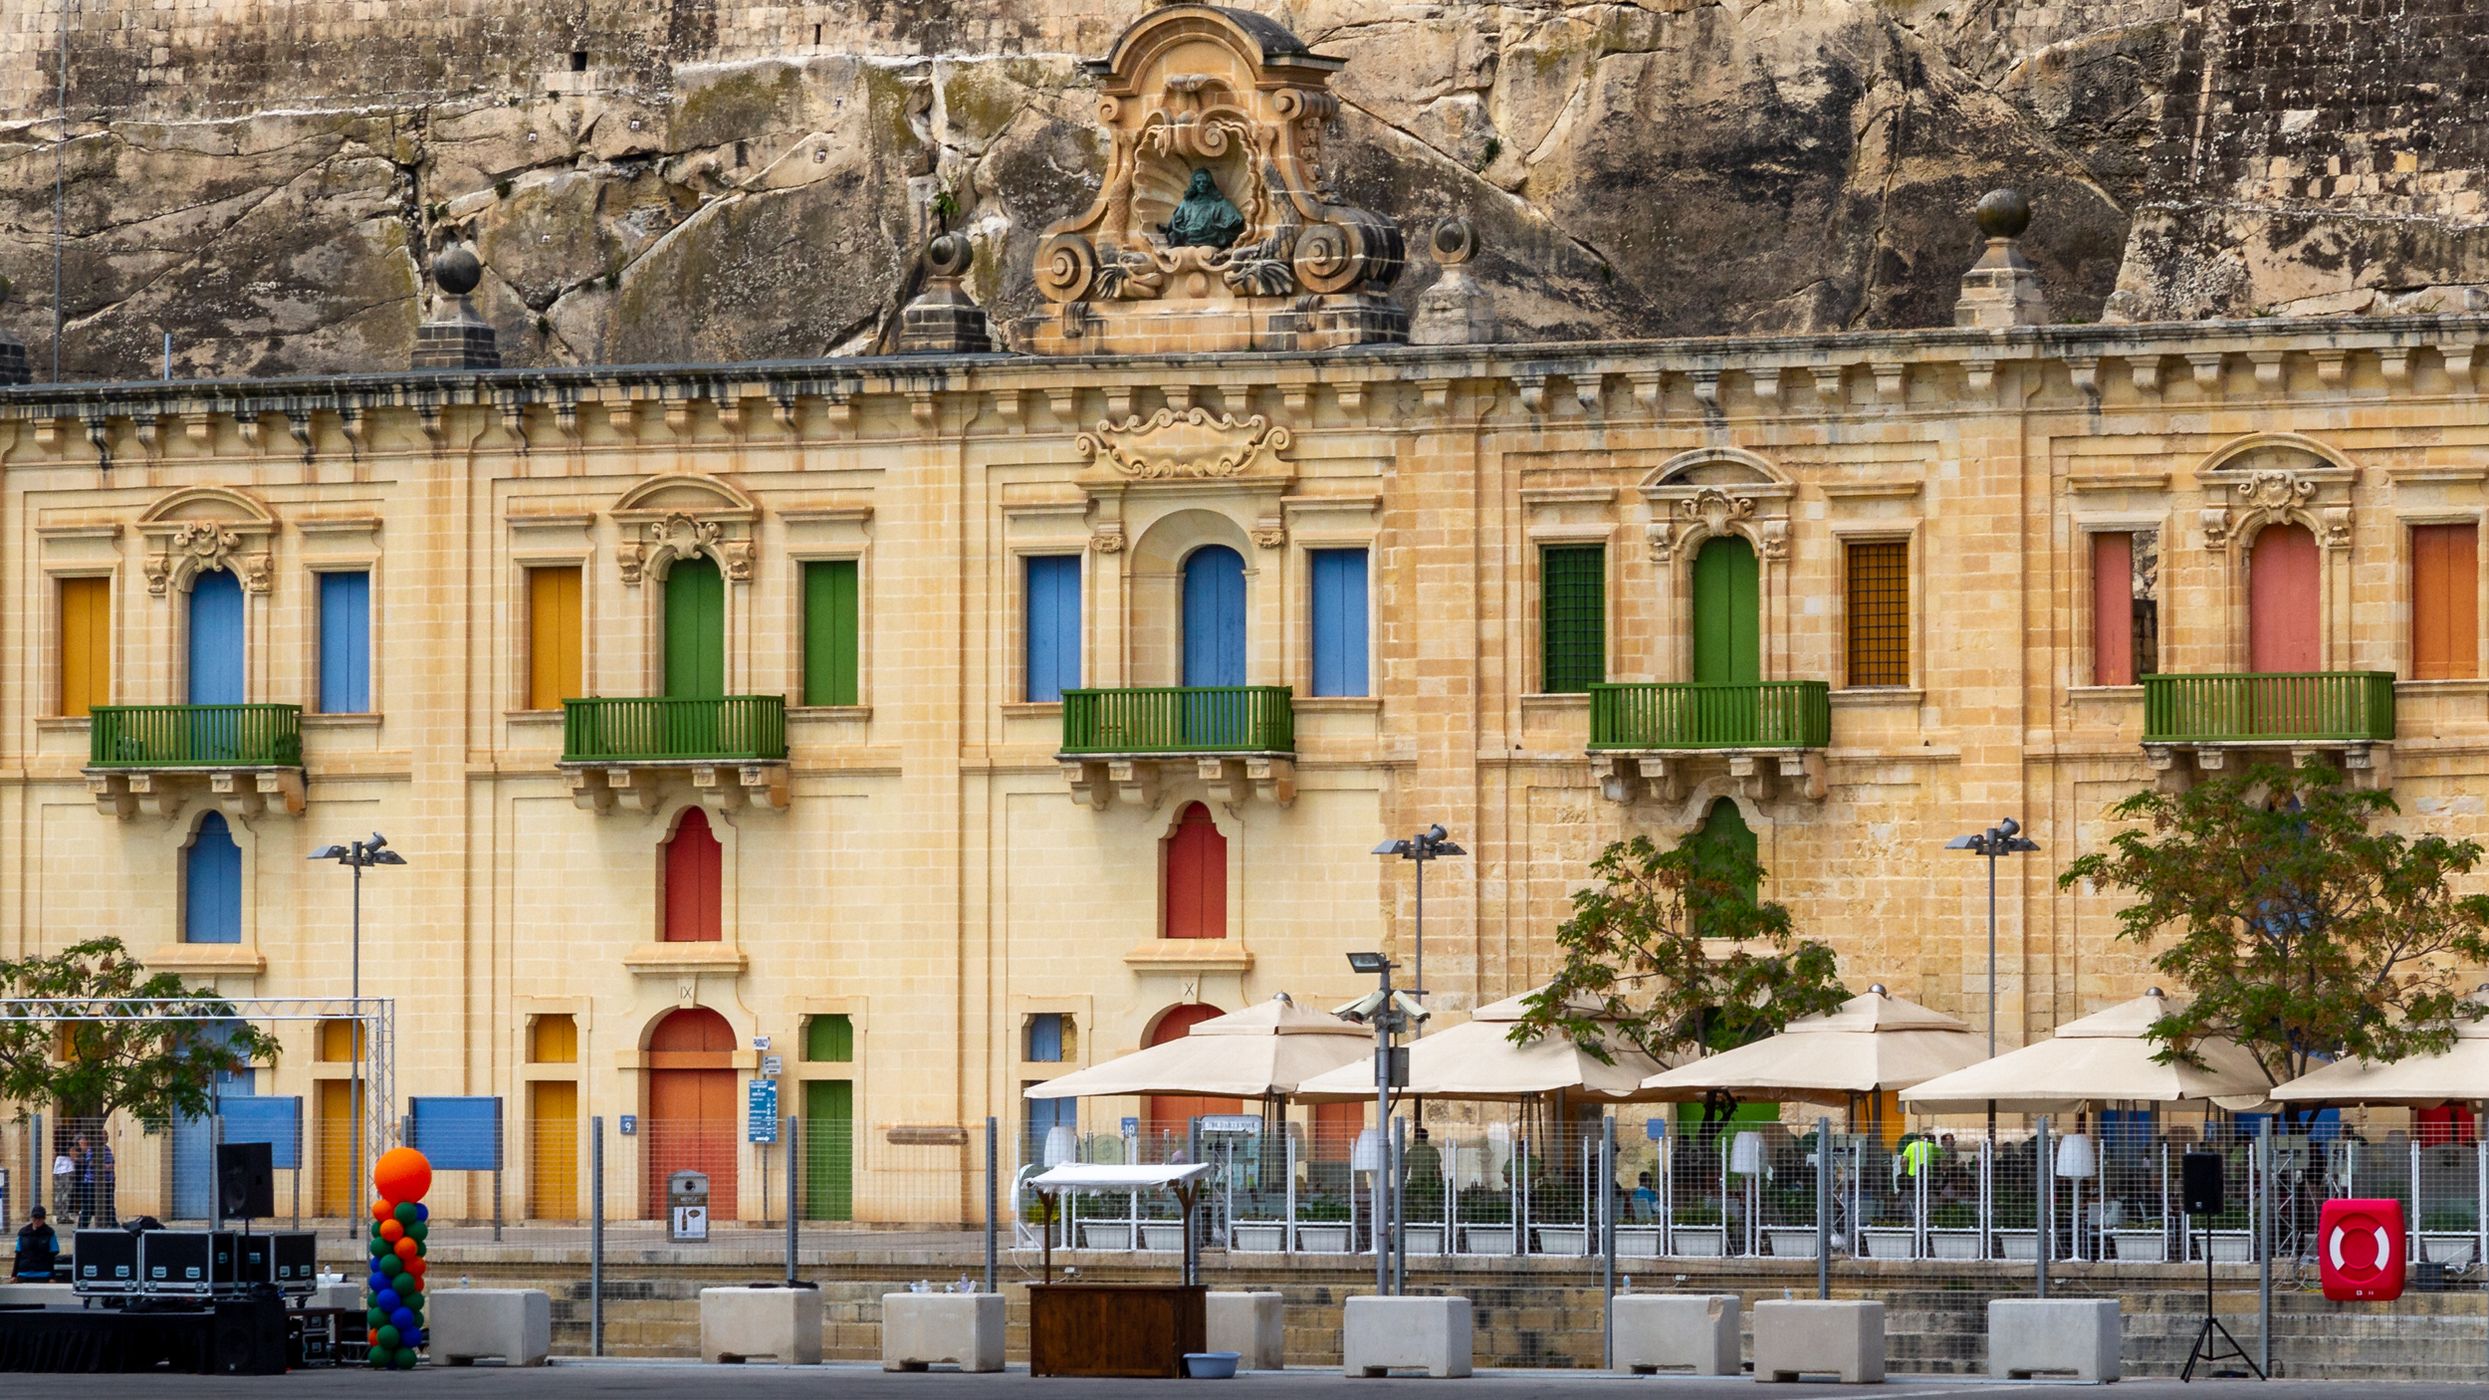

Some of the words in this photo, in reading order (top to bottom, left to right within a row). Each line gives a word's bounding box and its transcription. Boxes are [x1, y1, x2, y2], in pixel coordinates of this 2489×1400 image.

[680, 986, 692, 999] IX
[1185, 983, 1194, 996] X
[625, 1122, 631, 1133] 9
